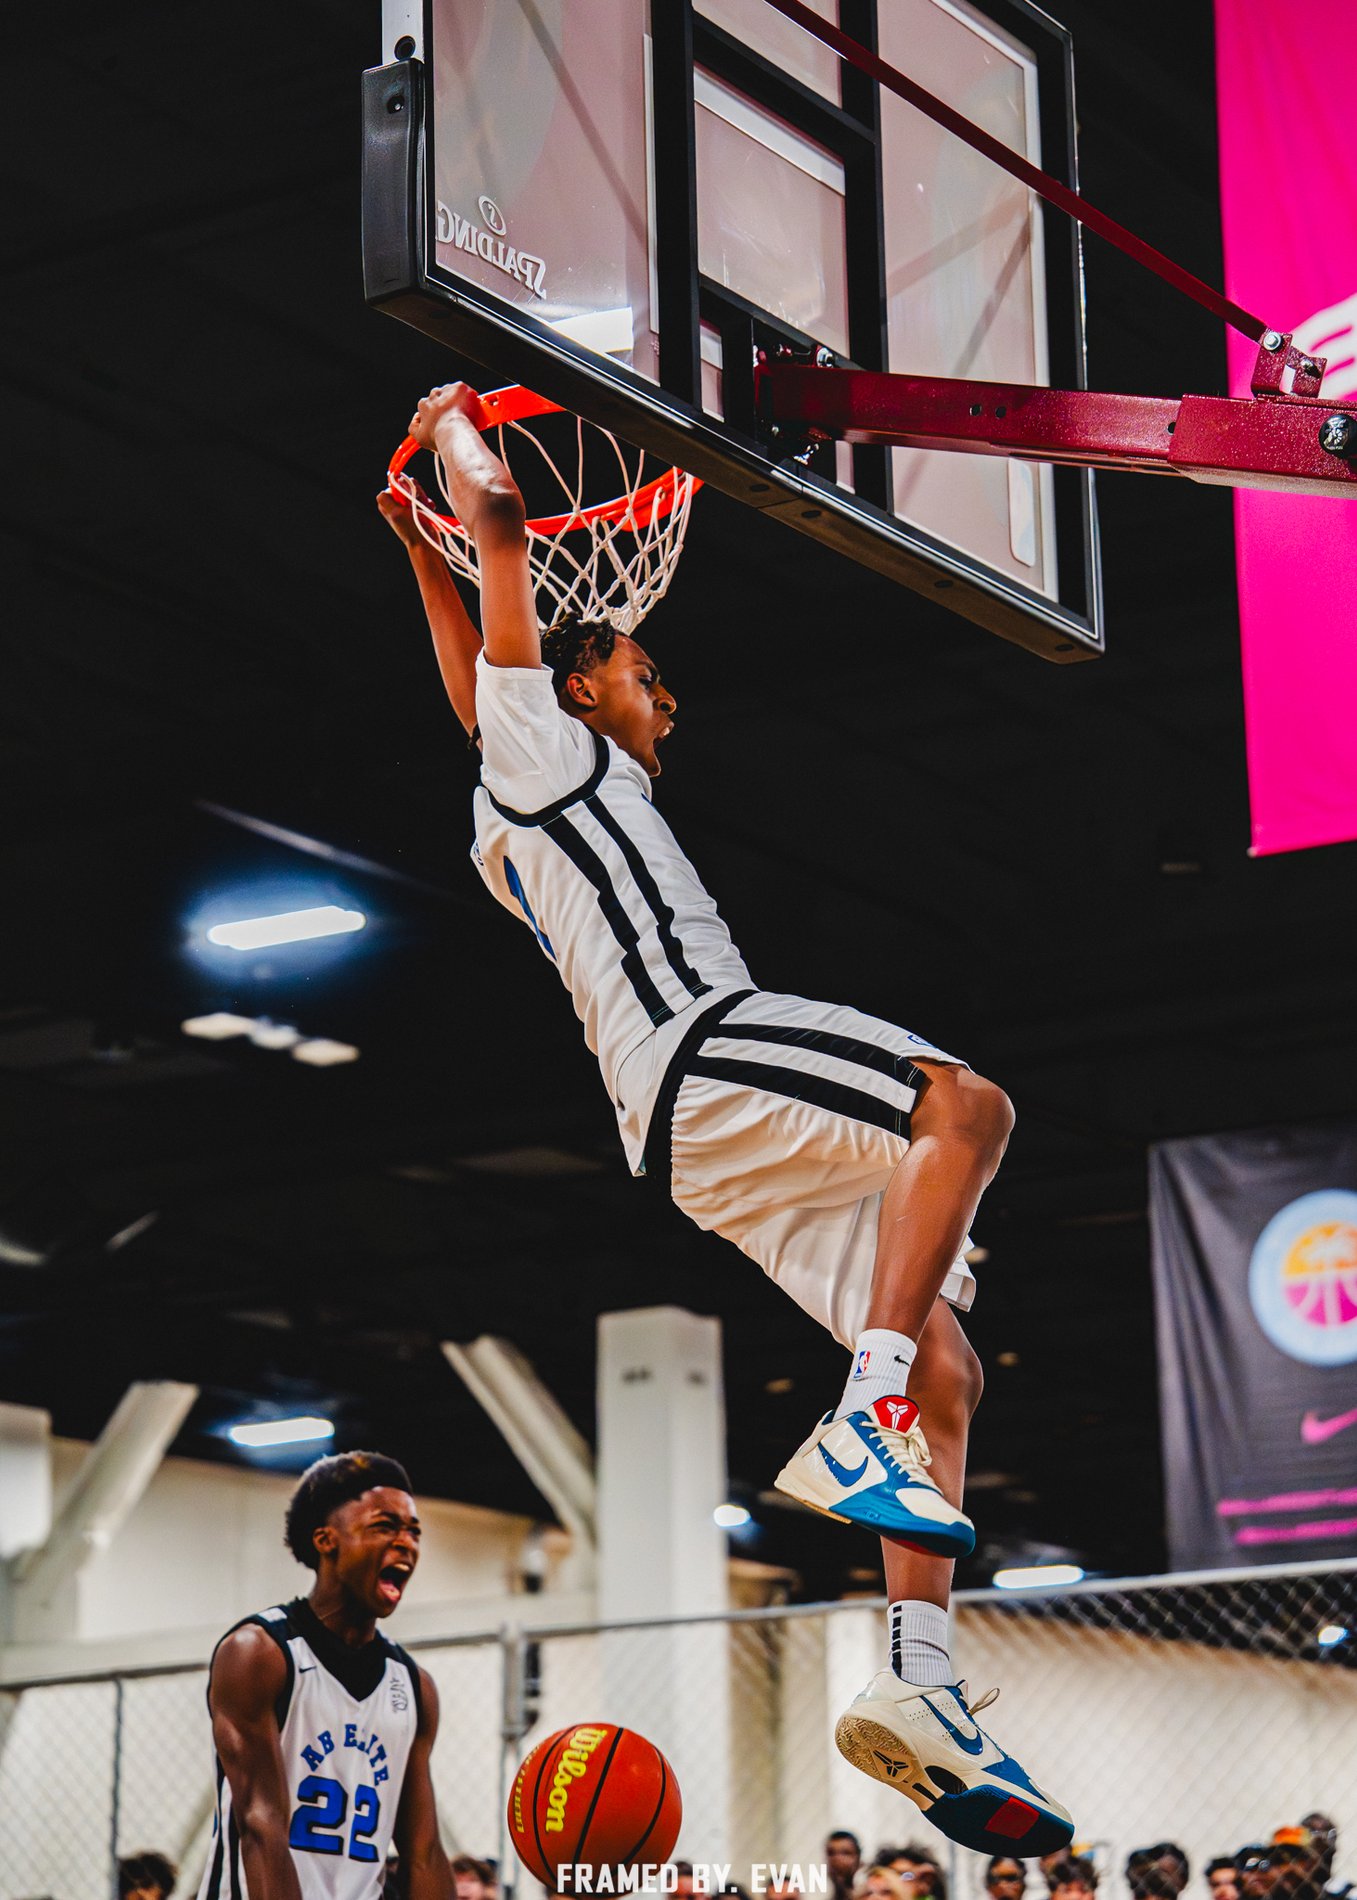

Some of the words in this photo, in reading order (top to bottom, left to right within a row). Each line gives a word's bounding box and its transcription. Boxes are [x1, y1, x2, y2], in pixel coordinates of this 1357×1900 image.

[300, 1730, 335, 1772] AB
[545, 1727, 608, 1833] Wilson
[289, 1774, 381, 1863] 22
